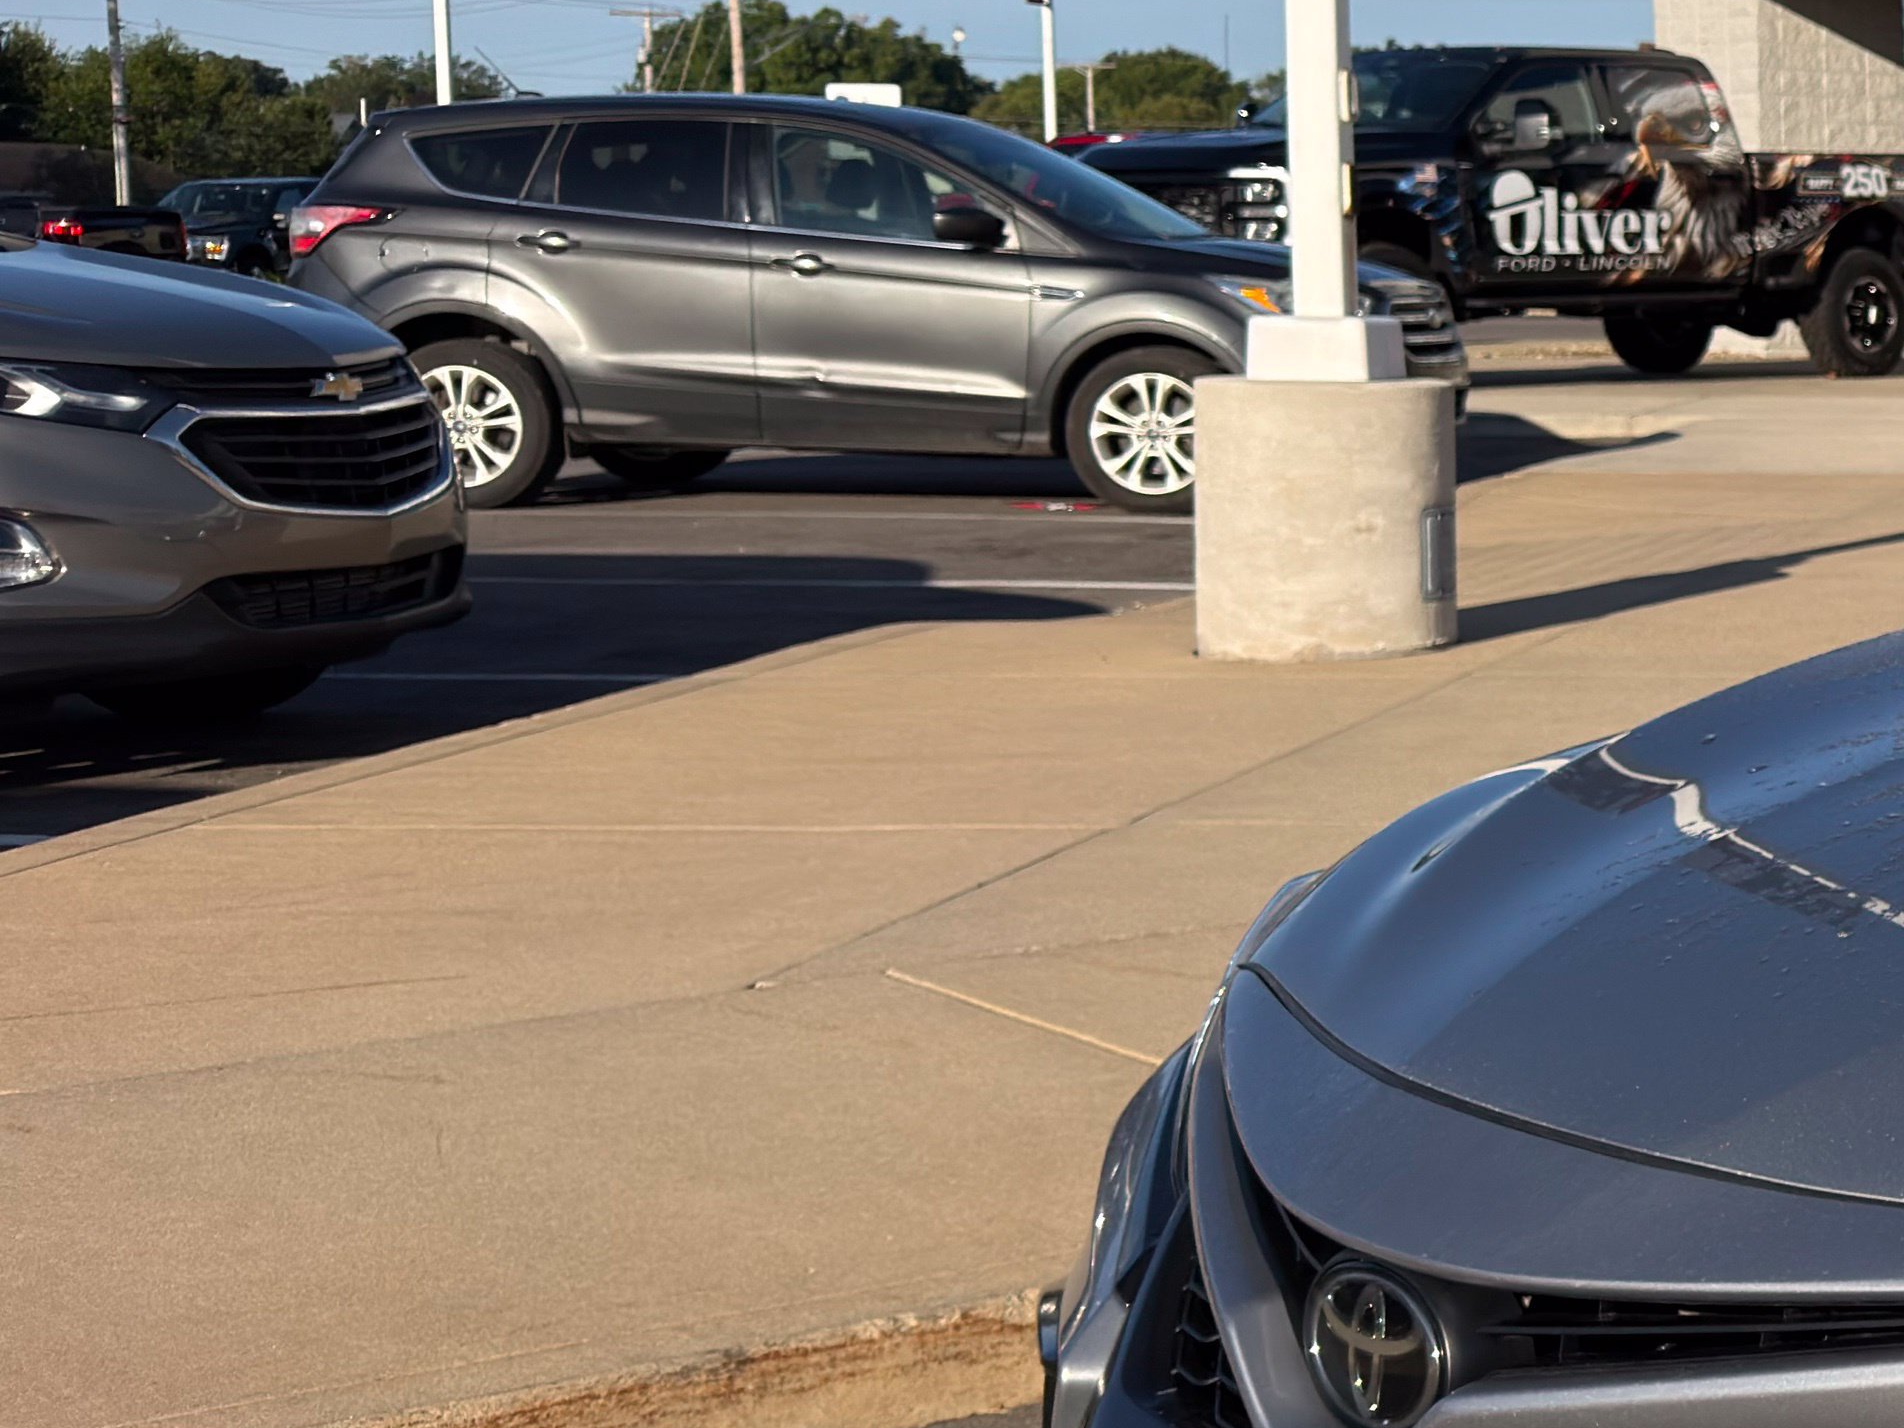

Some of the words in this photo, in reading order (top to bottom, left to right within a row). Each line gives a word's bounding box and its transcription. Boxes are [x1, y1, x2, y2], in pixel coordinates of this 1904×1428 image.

[1840, 164, 1888, 197] 250
[1489, 170, 1672, 256] Oliver
[1498, 256, 1556, 272] FORD
[1579, 255, 1671, 272] LINCOLN
